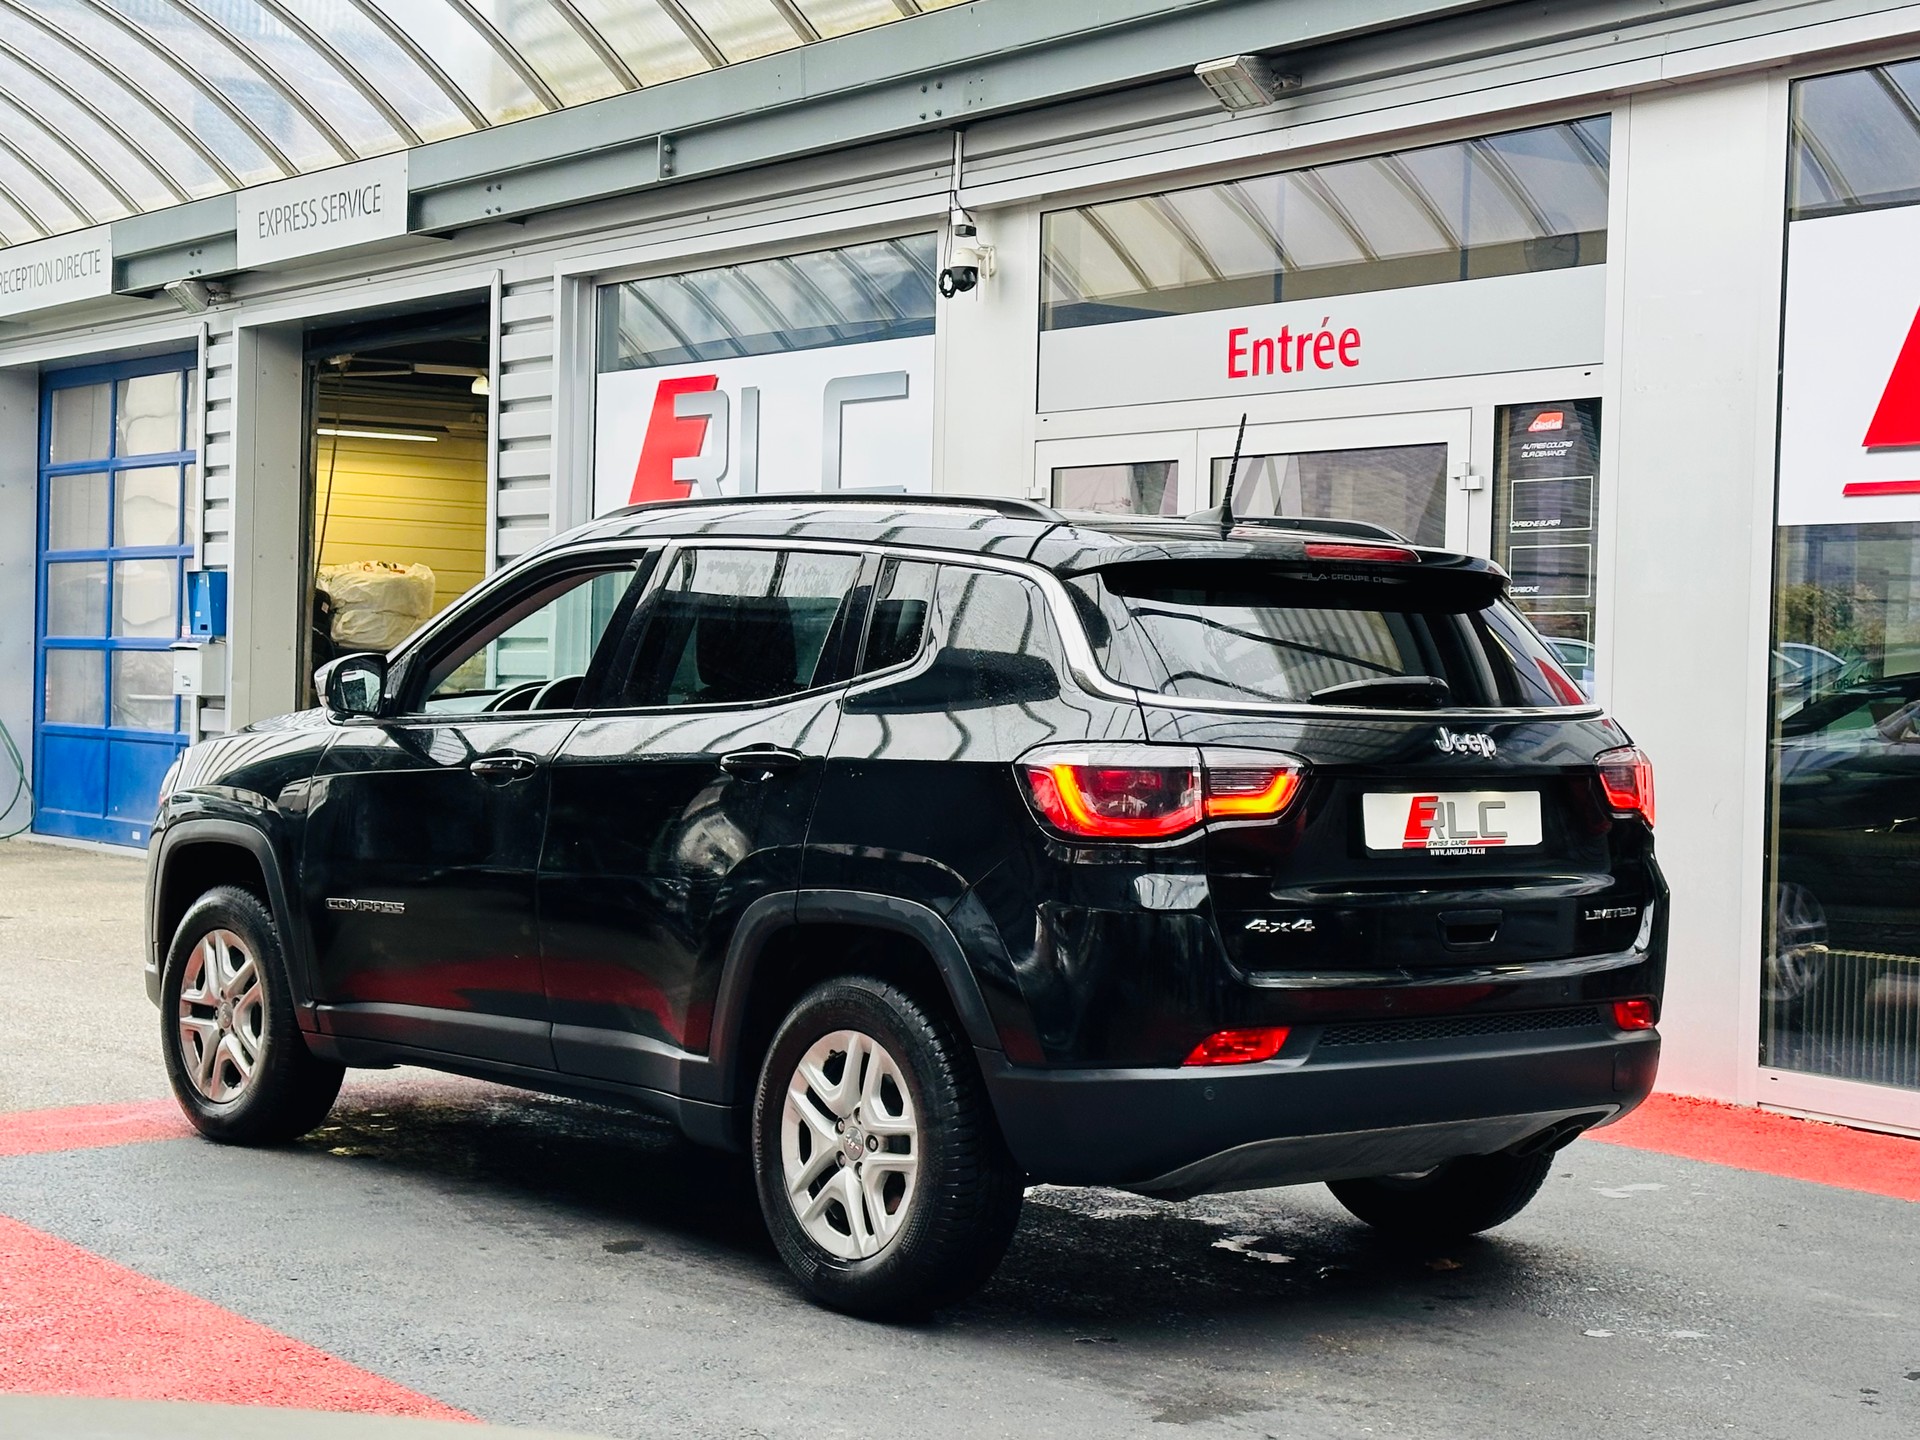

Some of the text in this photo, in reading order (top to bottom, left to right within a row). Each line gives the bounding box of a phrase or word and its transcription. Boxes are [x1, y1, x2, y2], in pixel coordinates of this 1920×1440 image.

[258, 184, 381, 239] EXPRESS SERVICE
[56, 249, 101, 282] DIRECTE
[1228, 316, 1361, 379] Entrée
[1535, 449, 1567, 457] DEMANDE
[1434, 726, 1497, 759] Jeep
[325, 897, 406, 914] COMPASS
[1584, 906, 1637, 920] LIMITED
[1245, 919, 1316, 933] 4x4
